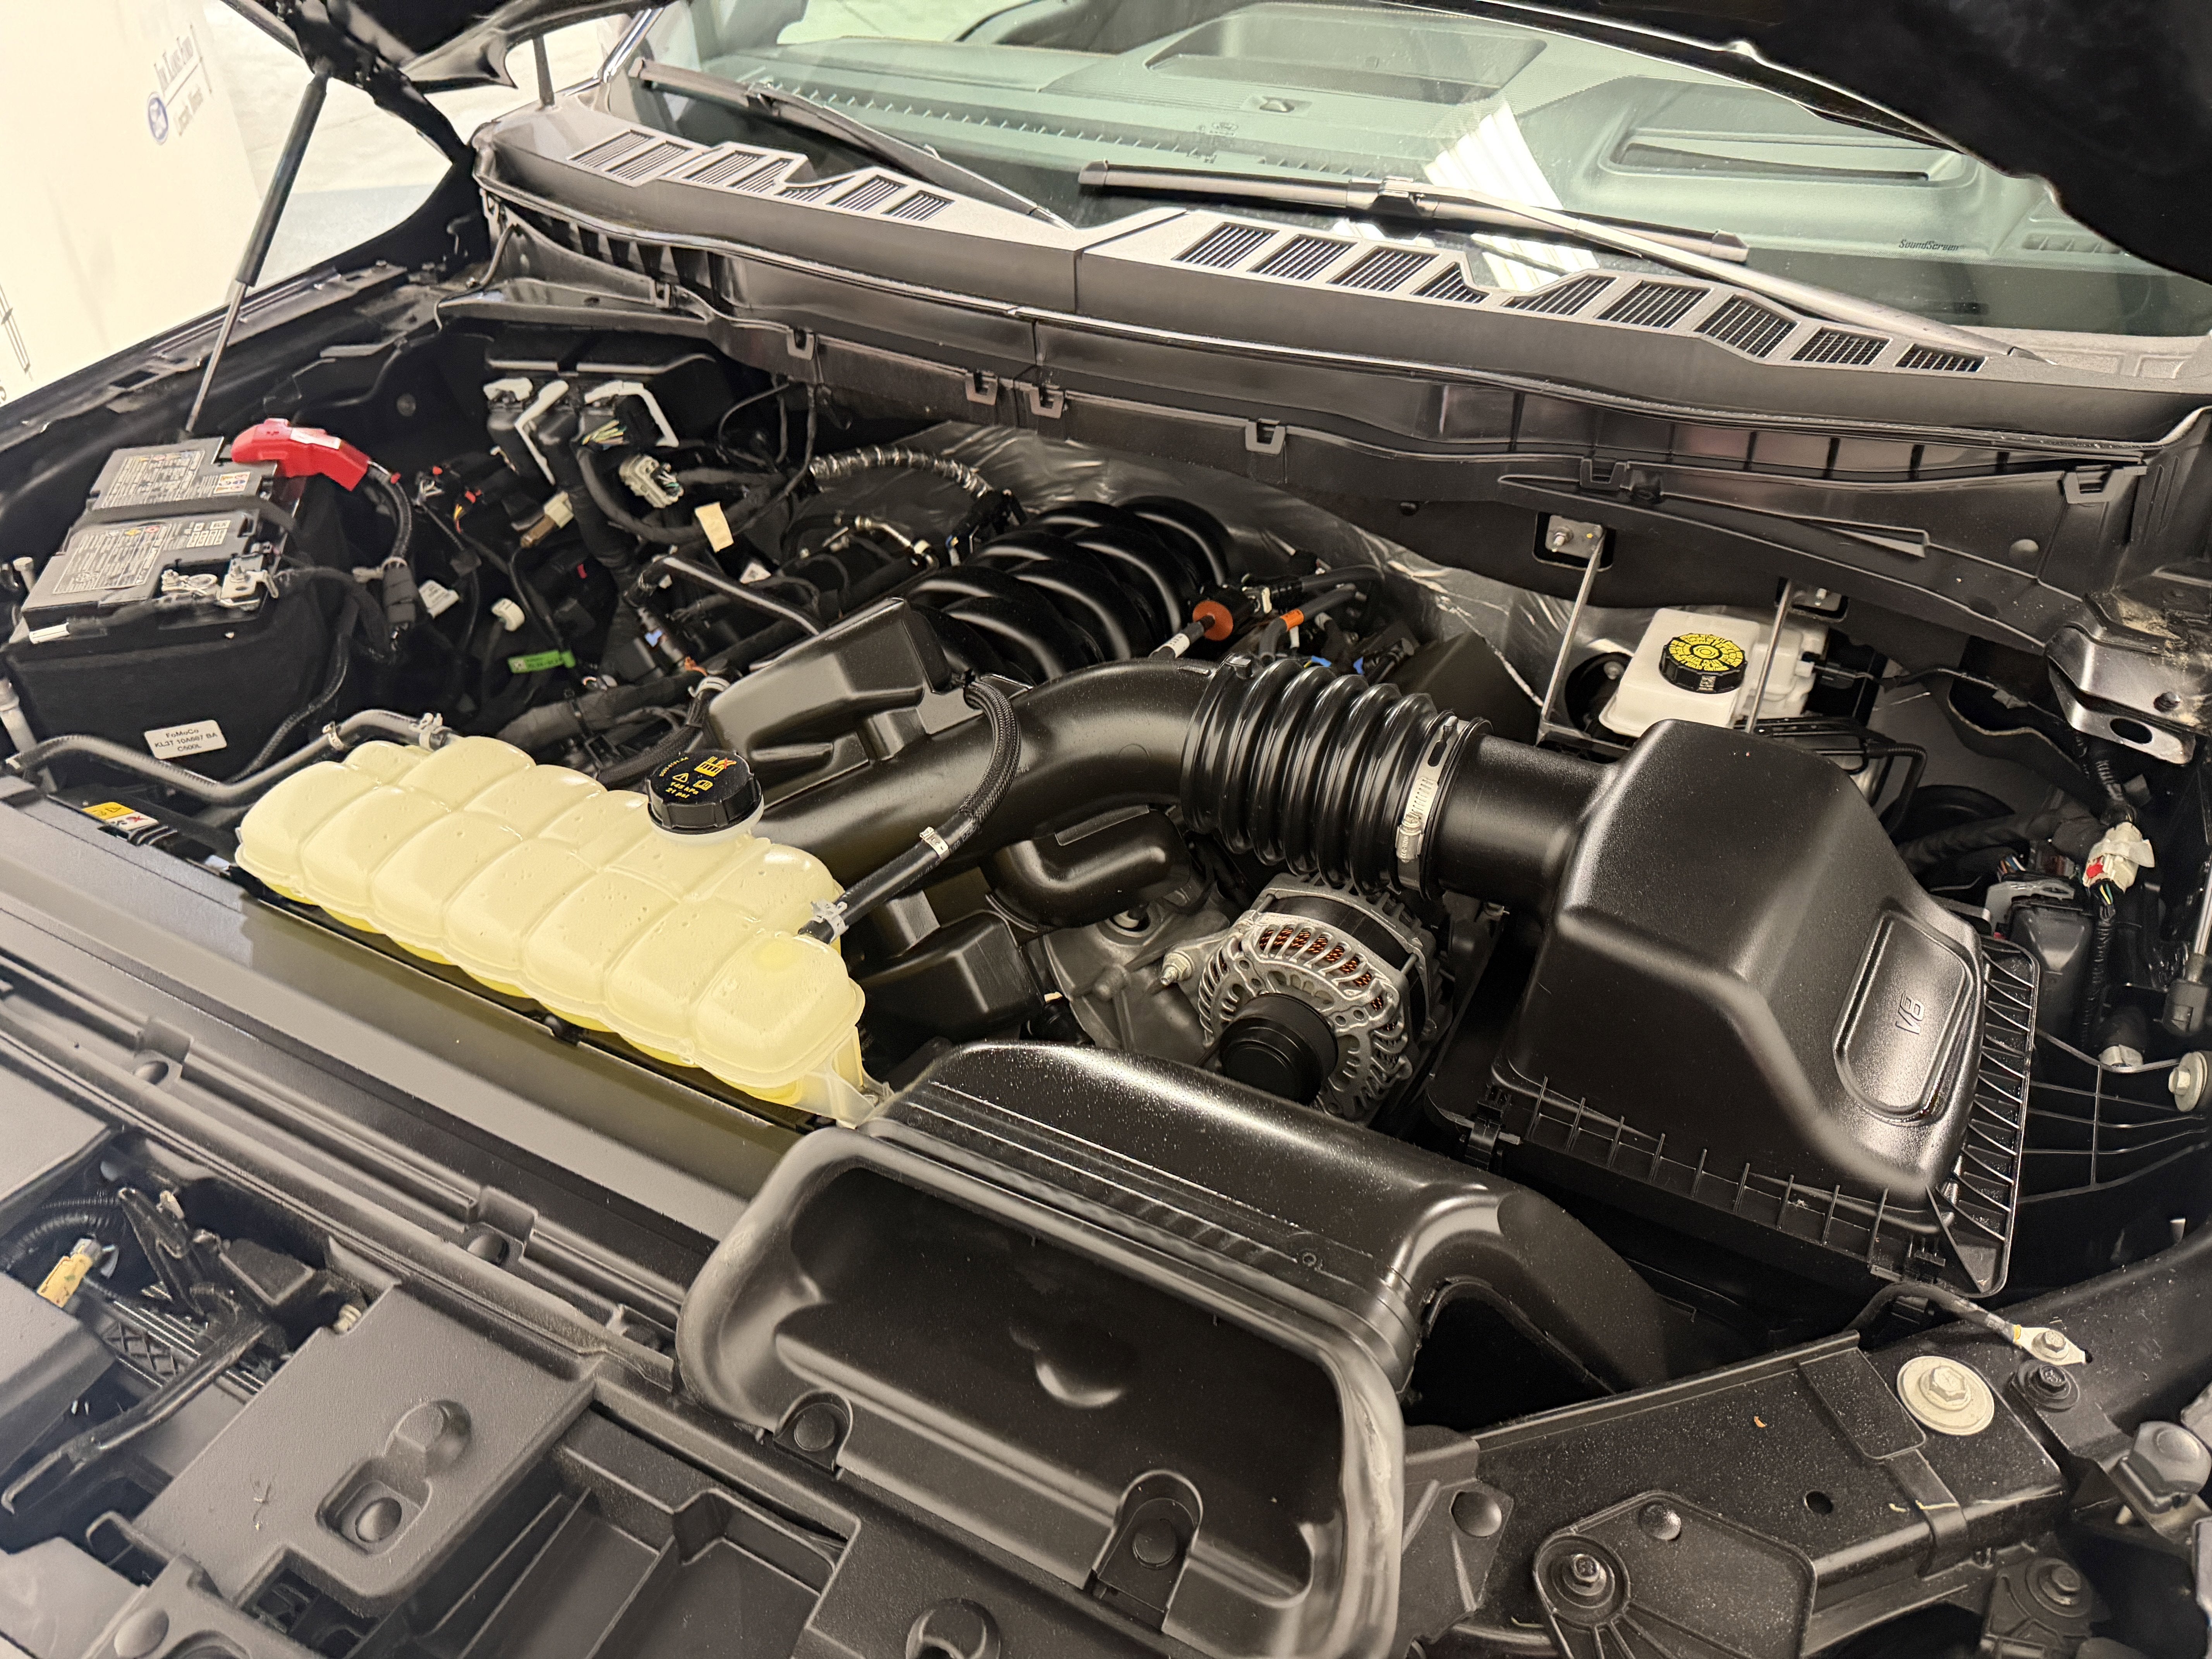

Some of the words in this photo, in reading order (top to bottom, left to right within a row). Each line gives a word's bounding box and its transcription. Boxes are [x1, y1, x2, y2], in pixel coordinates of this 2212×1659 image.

[1899, 239, 1959, 251] SoundScreen
[684, 787, 699, 795] kPa
[1895, 993, 1925, 1035] V8
